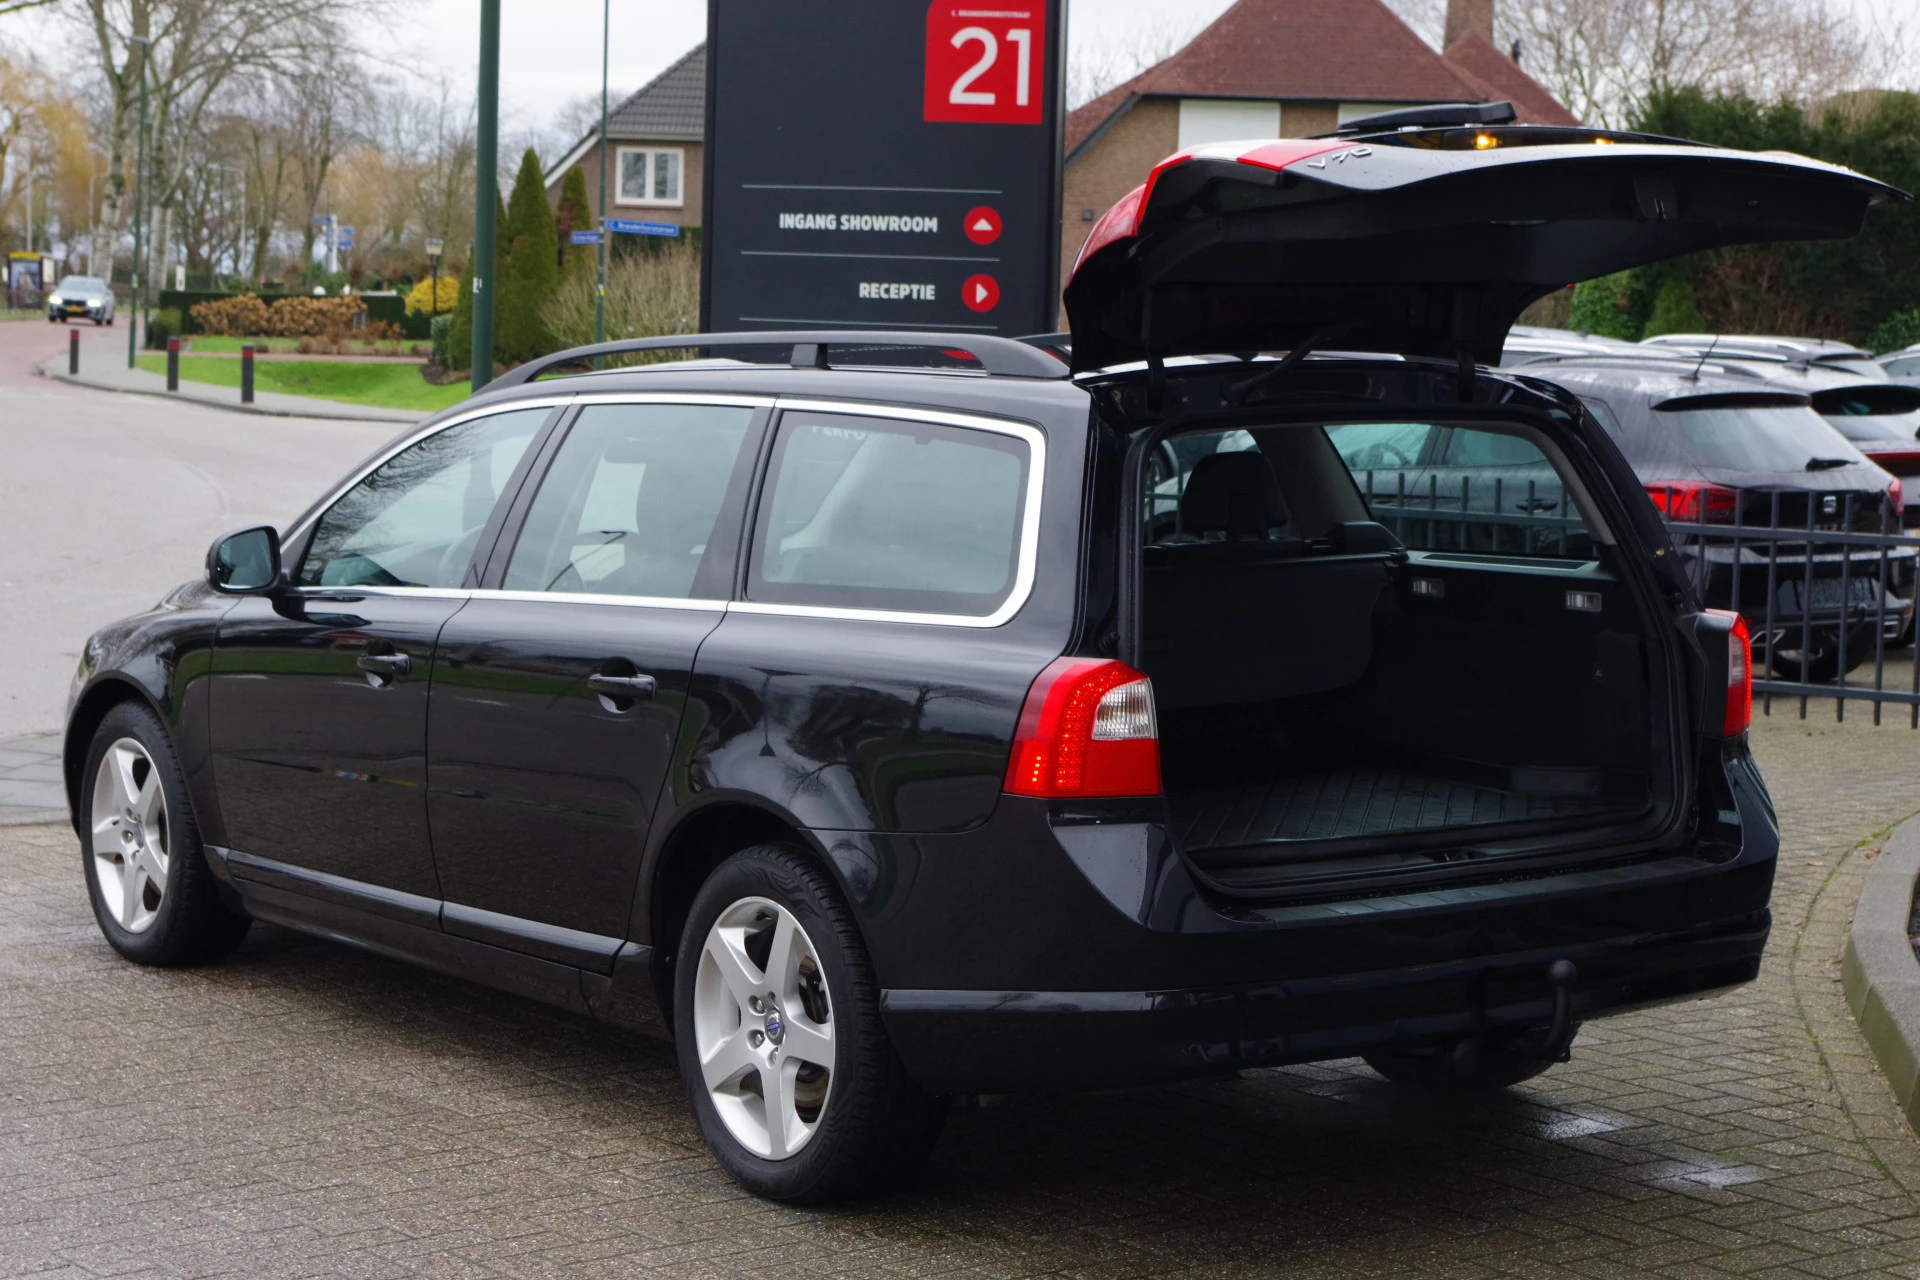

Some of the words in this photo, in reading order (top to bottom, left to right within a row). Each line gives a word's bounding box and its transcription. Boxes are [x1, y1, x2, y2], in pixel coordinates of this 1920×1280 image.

[949, 26, 1032, 106] 21
[1307, 148, 1372, 168] V70
[779, 213, 837, 230] INGANG
[840, 215, 938, 233] SHOWROOM
[859, 282, 936, 300] RECEPTIE
